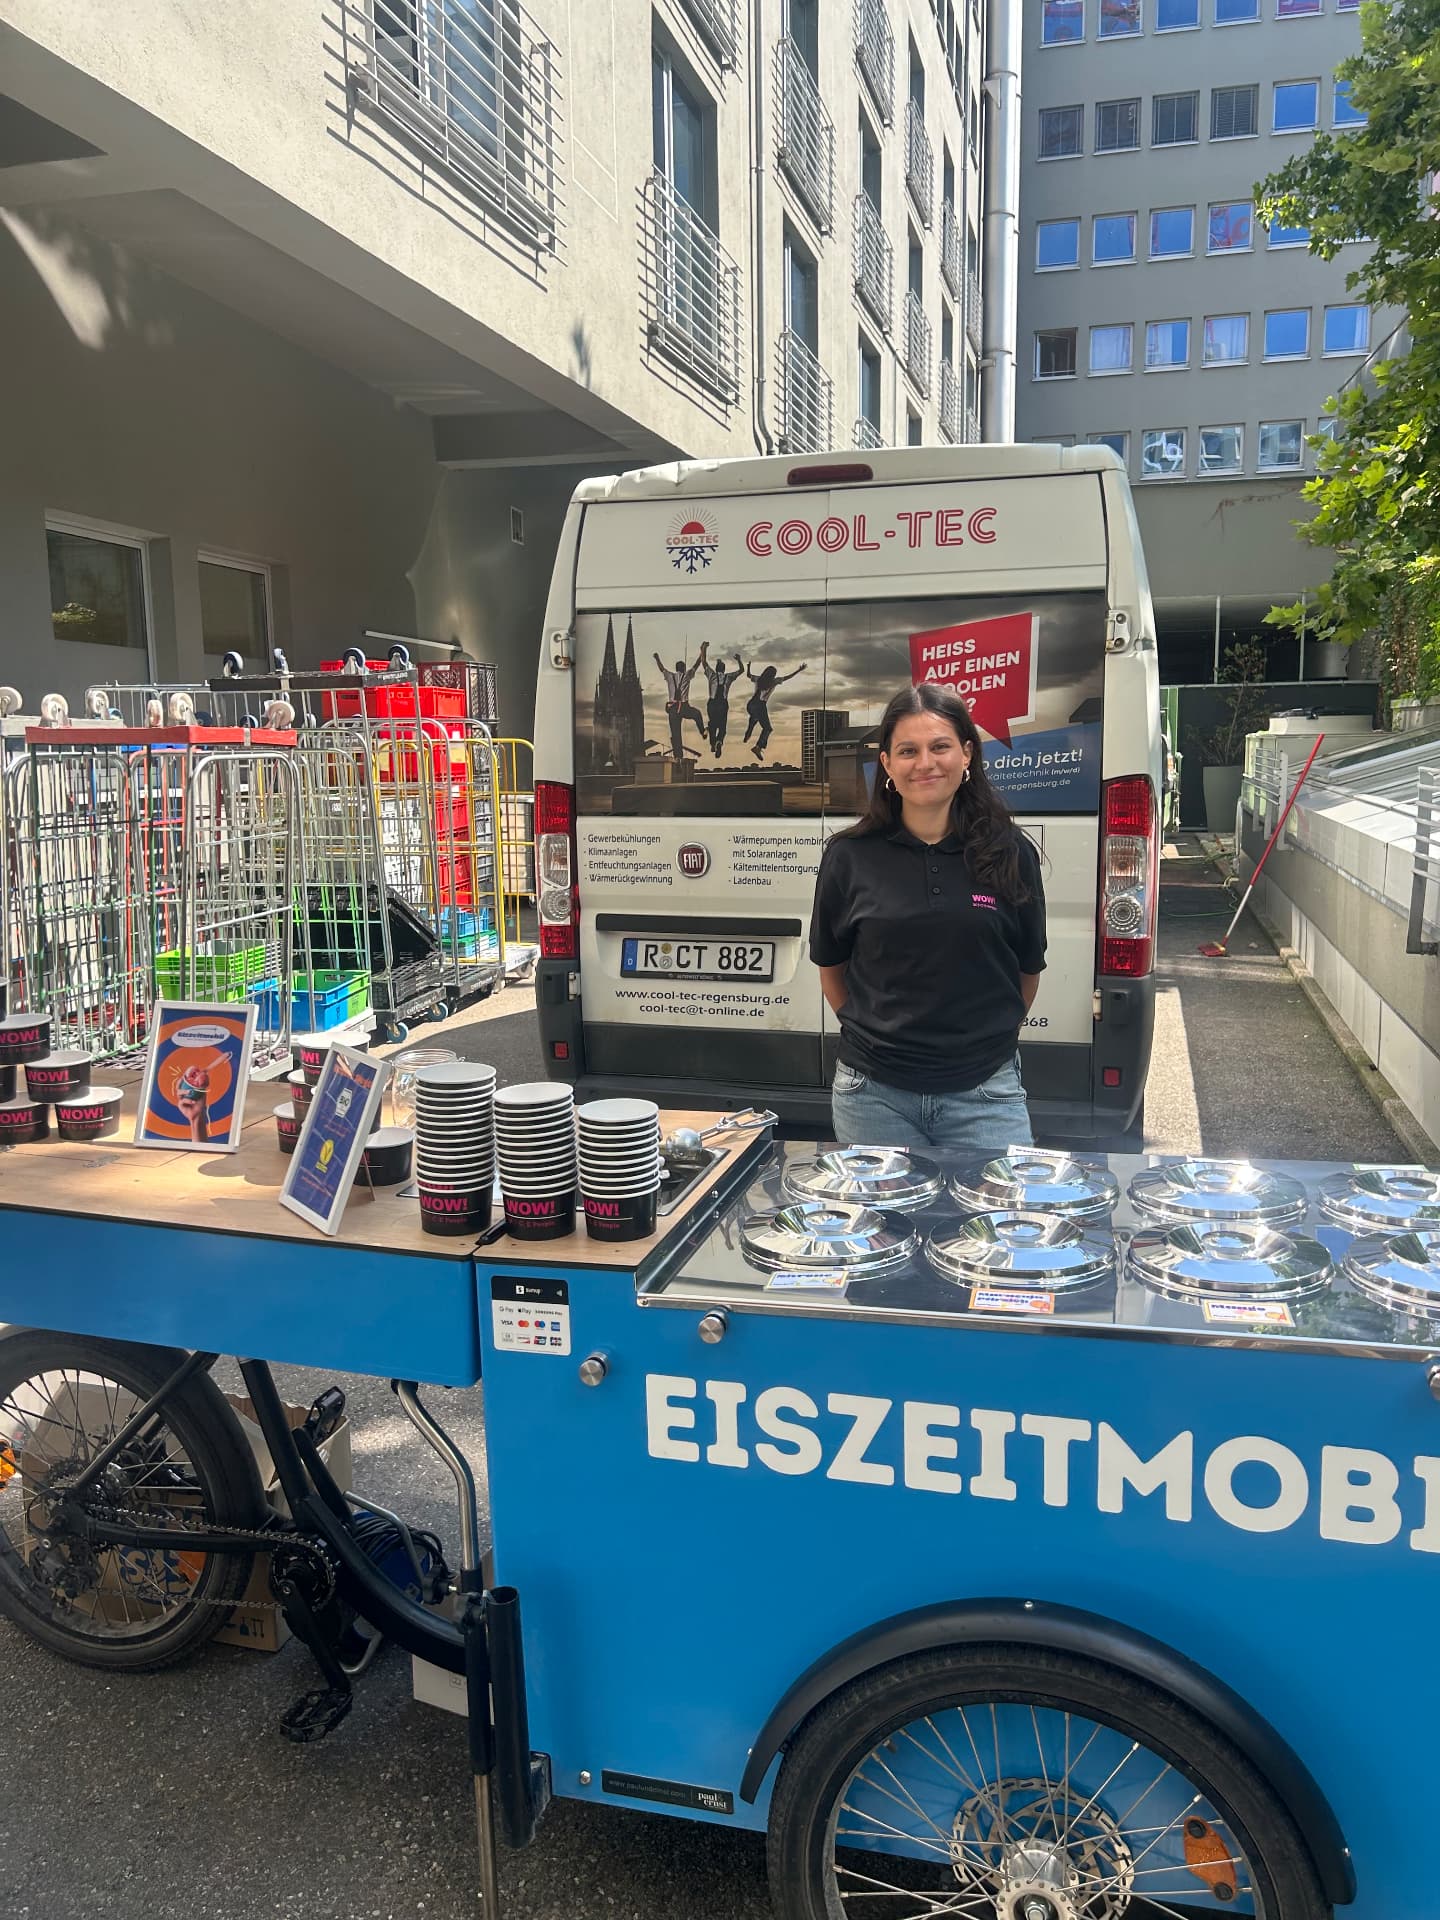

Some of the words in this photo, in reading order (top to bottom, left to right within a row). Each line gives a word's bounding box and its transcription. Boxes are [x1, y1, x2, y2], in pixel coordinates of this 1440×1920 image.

[746, 507, 997, 556] COOL-TEC
[922, 639, 976, 661] HEISS
[925, 661, 961, 681] AUF
[965, 650, 1020, 674] EINEN
[994, 753, 1033, 769] dich
[1035, 748, 1083, 768] jetzt!
[588, 834, 661, 845] Gewerbekühlungen
[733, 835, 792, 847] Wärmepumpen
[794, 836, 824, 846] kombin
[588, 847, 638, 858] Klimaanlagen
[732, 849, 745, 858] mit
[747, 849, 797, 861] Solaranlagen
[588, 860, 672, 872] Entfeuchtungsanlagen
[682, 852, 703, 869] FIAT
[733, 863, 819, 876] Kältemittelentsorgung
[589, 874, 673, 886] Wärmerückgewinnung
[733, 876, 772, 886] Ladenbau
[643, 944, 659, 968] R
[676, 945, 708, 969] CT
[718, 946, 763, 971] 882
[615, 989, 790, 1006] www.cool-tec-regensburg.de
[639, 1003, 765, 1018] cool-tec@t-online.de
[27, 1069, 69, 1082] WOW!
[0, 1110, 33, 1124] OW!
[60, 1106, 104, 1120] WOW!
[420, 1195, 468, 1212] WOW!
[506, 1199, 556, 1216] WOW!
[697, 1792, 718, 1803] paul
